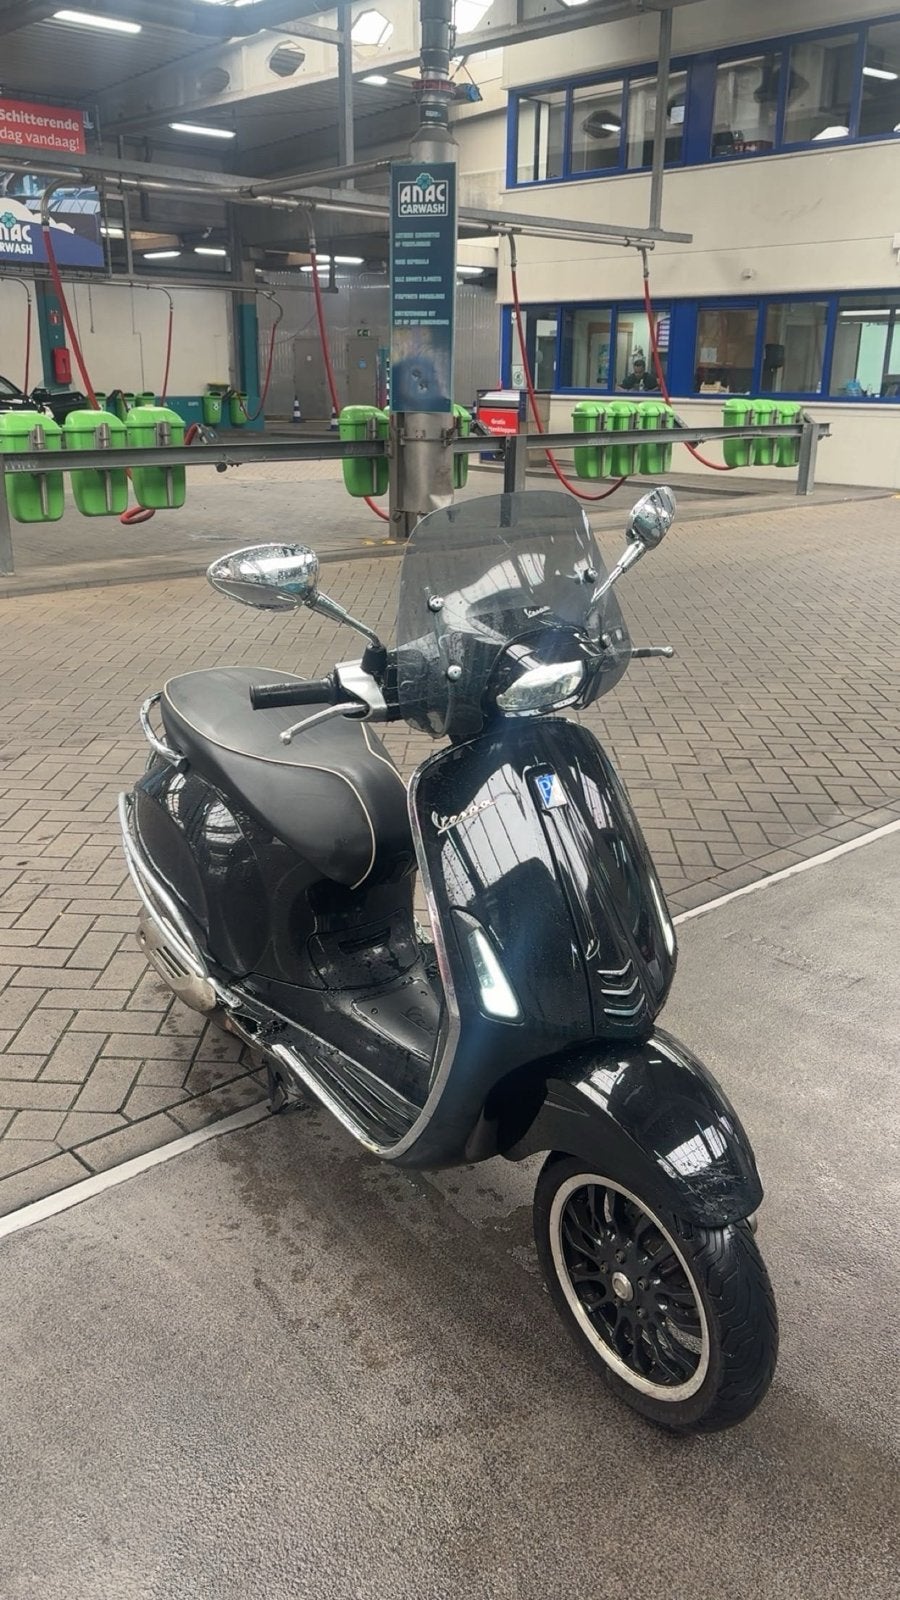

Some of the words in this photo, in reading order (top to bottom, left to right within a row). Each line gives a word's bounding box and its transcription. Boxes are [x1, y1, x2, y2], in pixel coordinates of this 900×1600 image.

[0, 108, 80, 131] Schitterende
[0, 126, 23, 144] dag
[25, 133, 80, 152] vandaag!
[400, 183, 446, 203] ANAC
[400, 203, 446, 214] CARWASH
[0, 223, 33, 242] NAC
[0, 241, 34, 255] RWASH
